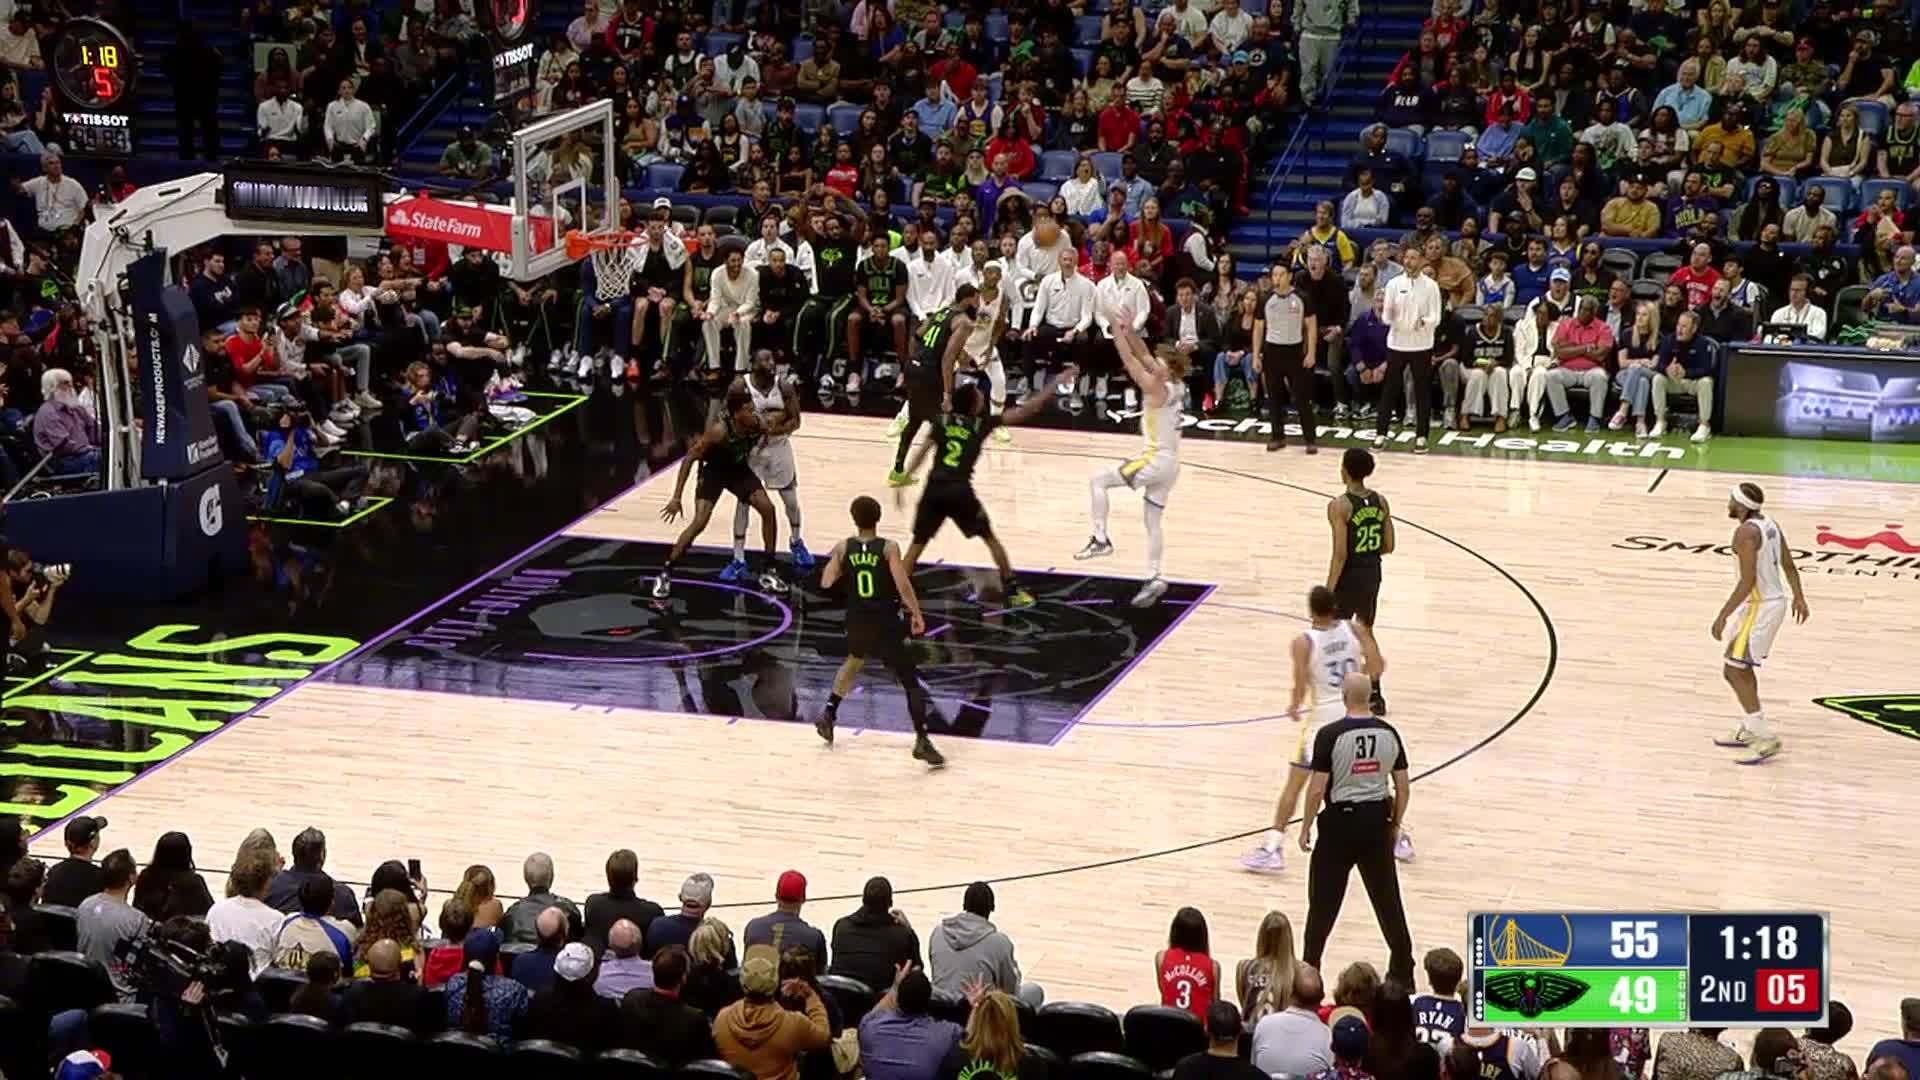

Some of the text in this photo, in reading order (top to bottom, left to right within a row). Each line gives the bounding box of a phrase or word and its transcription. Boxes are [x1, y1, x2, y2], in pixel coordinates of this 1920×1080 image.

[81, 46, 118, 67] 1:18
[504, 44, 534, 66] TISSOT
[94, 68, 112, 96] 5
[80, 114, 129, 126] TISSOT
[924, 325, 940, 347] 41
[148, 312, 166, 444] NEWAGEPRODUCTS.CM
[1181, 412, 1686, 460] chsner Health
[943, 440, 962, 468] 2
[1355, 524, 1381, 552] 25
[1611, 536, 1920, 569] SMTHI
[857, 570, 874, 598] 0
[1798, 564, 1920, 580] CENT
[0, 624, 361, 834] LICANS
[1354, 734, 1377, 759] 37
[1176, 980, 1191, 1009] 3
[1419, 1011, 1455, 1029] RYAN
